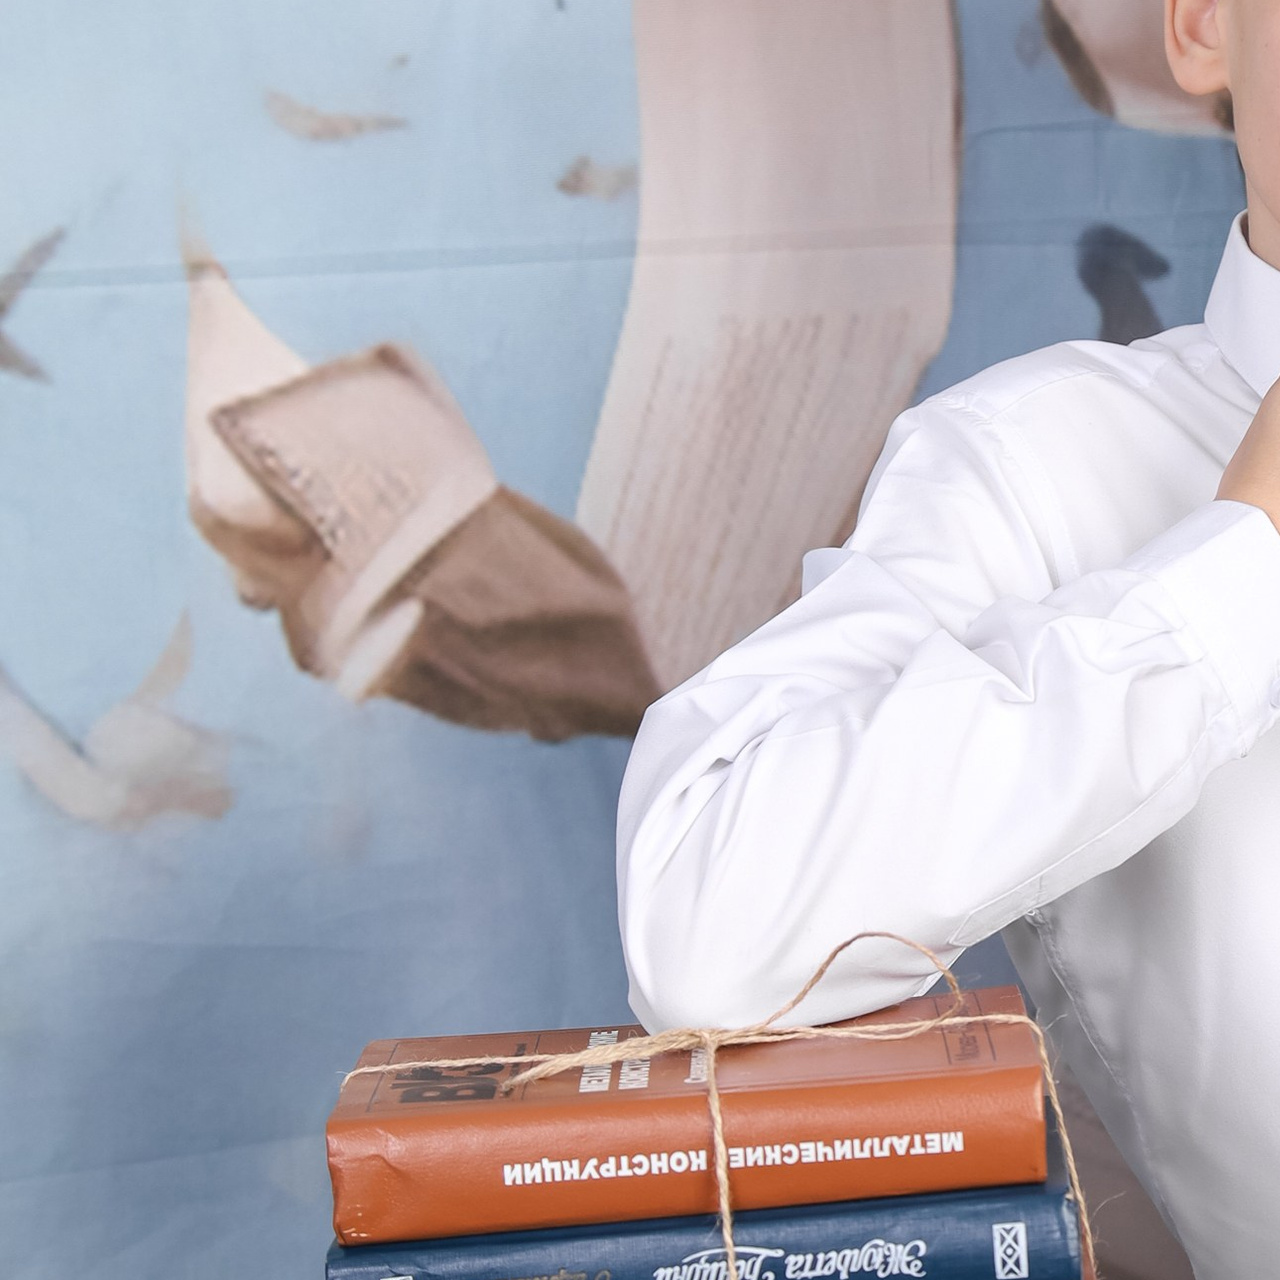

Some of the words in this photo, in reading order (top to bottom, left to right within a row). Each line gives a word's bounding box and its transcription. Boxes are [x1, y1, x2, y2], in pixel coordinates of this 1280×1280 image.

[503, 1149, 707, 1186] КОНСТРУКЦИИ
[729, 1131, 965, 1169] МЕТАЛЛИЧЕСКИЕ
[784, 1238, 927, 1280] Жюльетта
